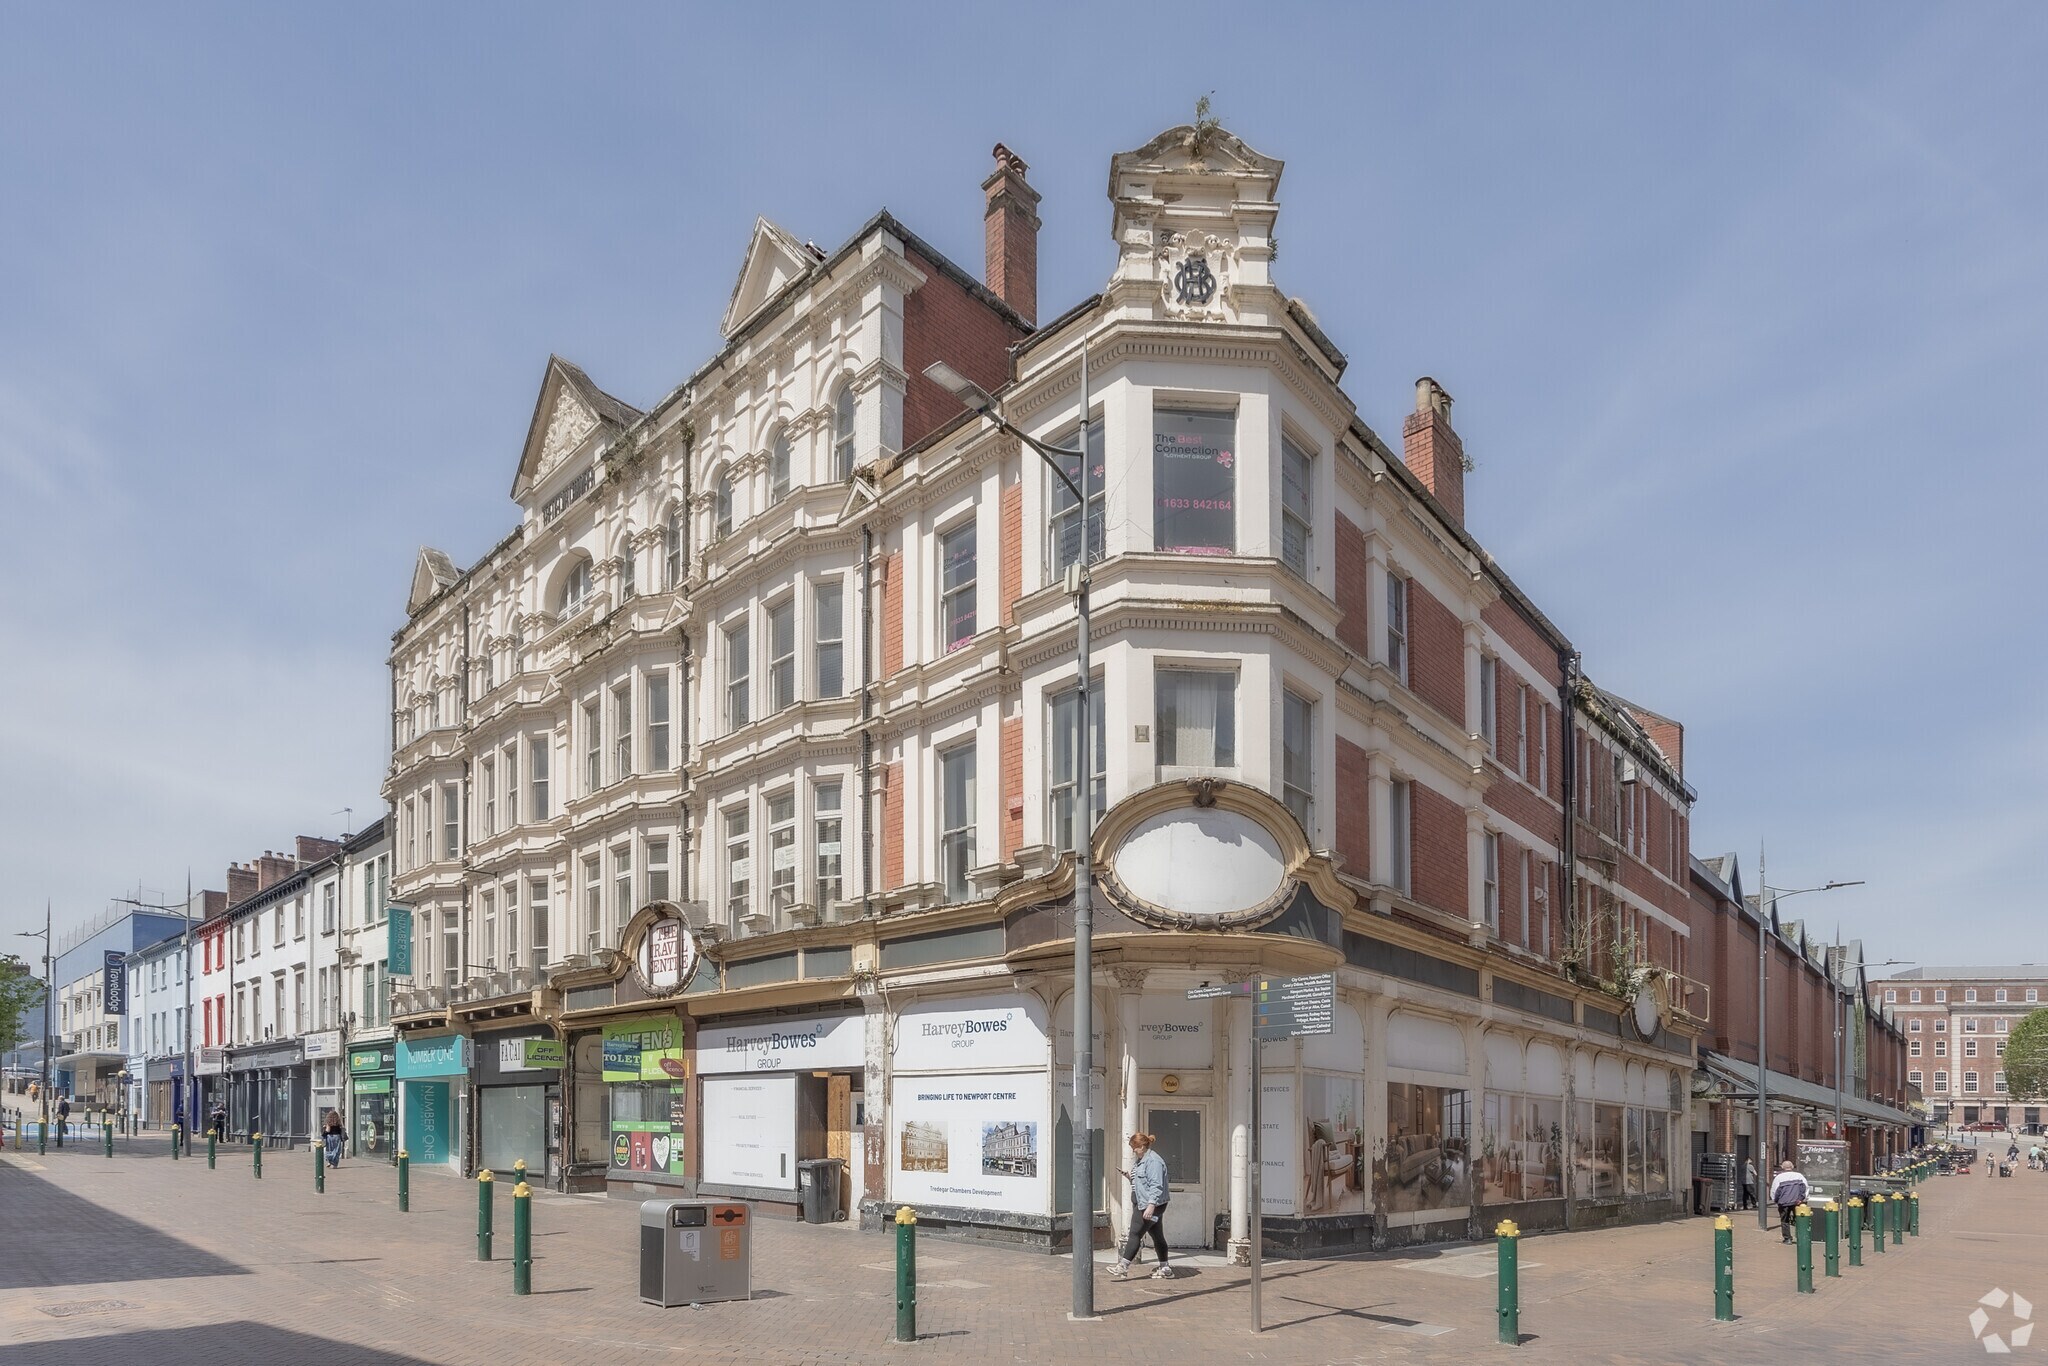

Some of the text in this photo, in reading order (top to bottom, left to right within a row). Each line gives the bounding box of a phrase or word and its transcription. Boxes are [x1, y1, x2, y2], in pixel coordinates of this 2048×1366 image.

[1155, 434, 1202, 445] The Best
[1155, 444, 1219, 455] Connection
[1193, 499, 1232, 511] 842164
[397, 912, 407, 951] NUMBER
[657, 924, 678, 941] THE
[396, 952, 406, 972] ONE
[108, 967, 121, 1012] Travelodge
[922, 1020, 1007, 1038] HarveyBowes
[1139, 1023, 1199, 1034] rveyBowes
[726, 1032, 816, 1055] HarveyBowes
[951, 1040, 974, 1048] GROUP
[408, 1047, 436, 1064] NUMBER
[437, 1045, 454, 1064] ONE
[757, 1058, 781, 1068] GROUP
[943, 1093, 954, 1101] LIFE
[992, 1092, 1016, 1100] CENTRE
[422, 1085, 435, 1160] NUMBER ONE
[930, 1185, 949, 1193] Tredegar
[972, 1189, 1002, 1197] Development
